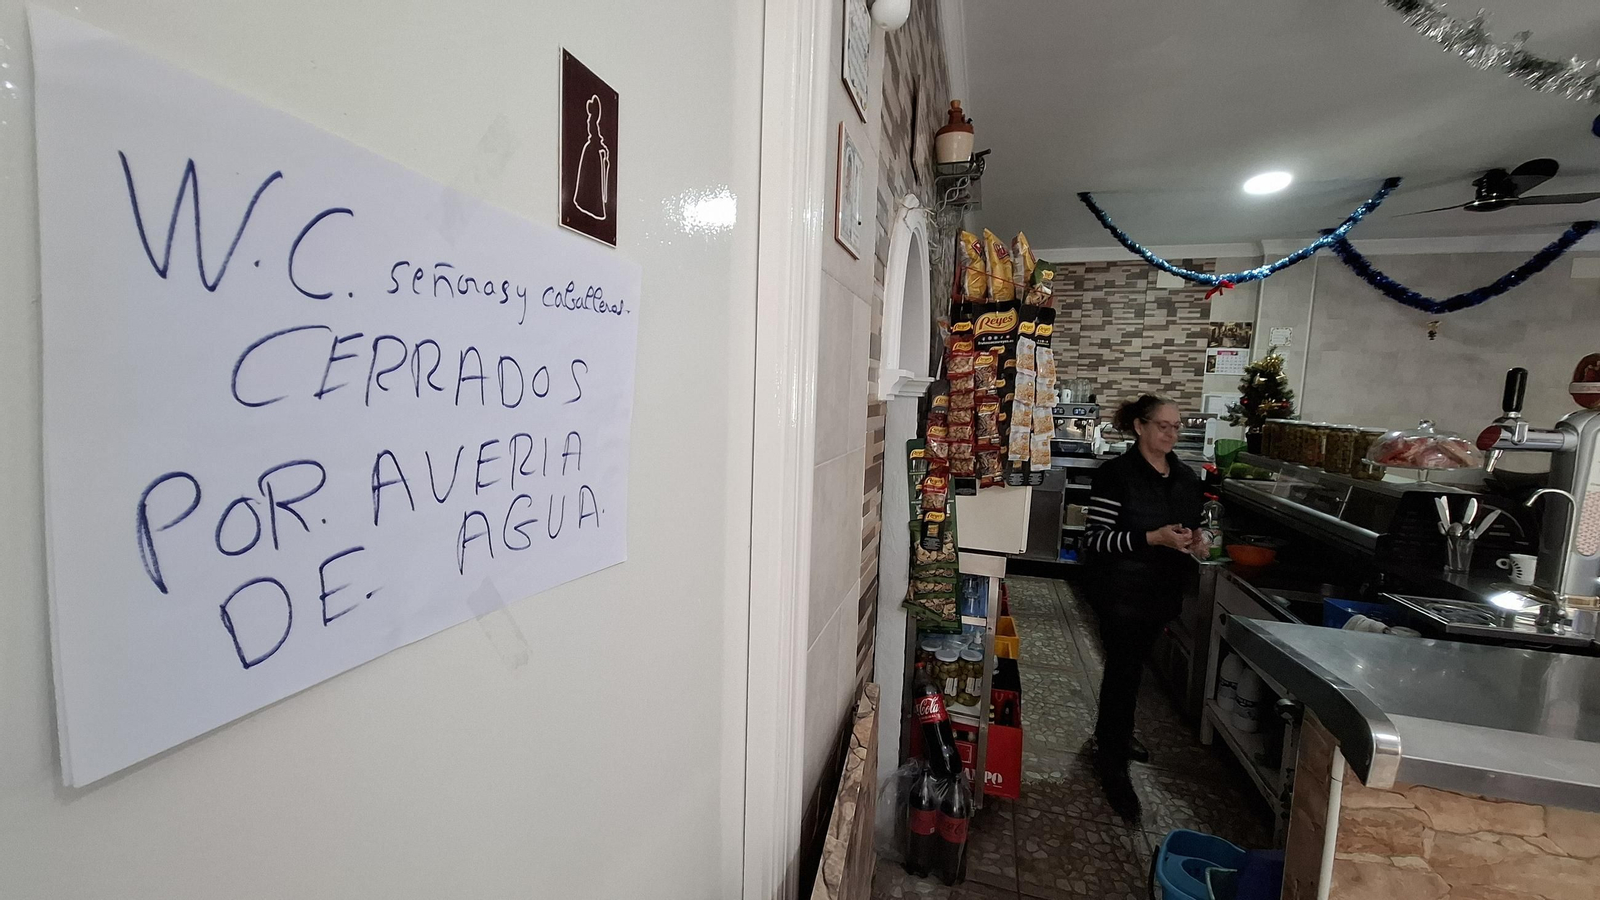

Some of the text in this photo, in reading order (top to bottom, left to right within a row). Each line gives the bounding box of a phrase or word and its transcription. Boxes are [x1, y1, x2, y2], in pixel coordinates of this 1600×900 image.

[979, 315, 1014, 330] Reyes
[231, 325, 589, 408] CERRADOS
[371, 431, 582, 527] AVERIA
